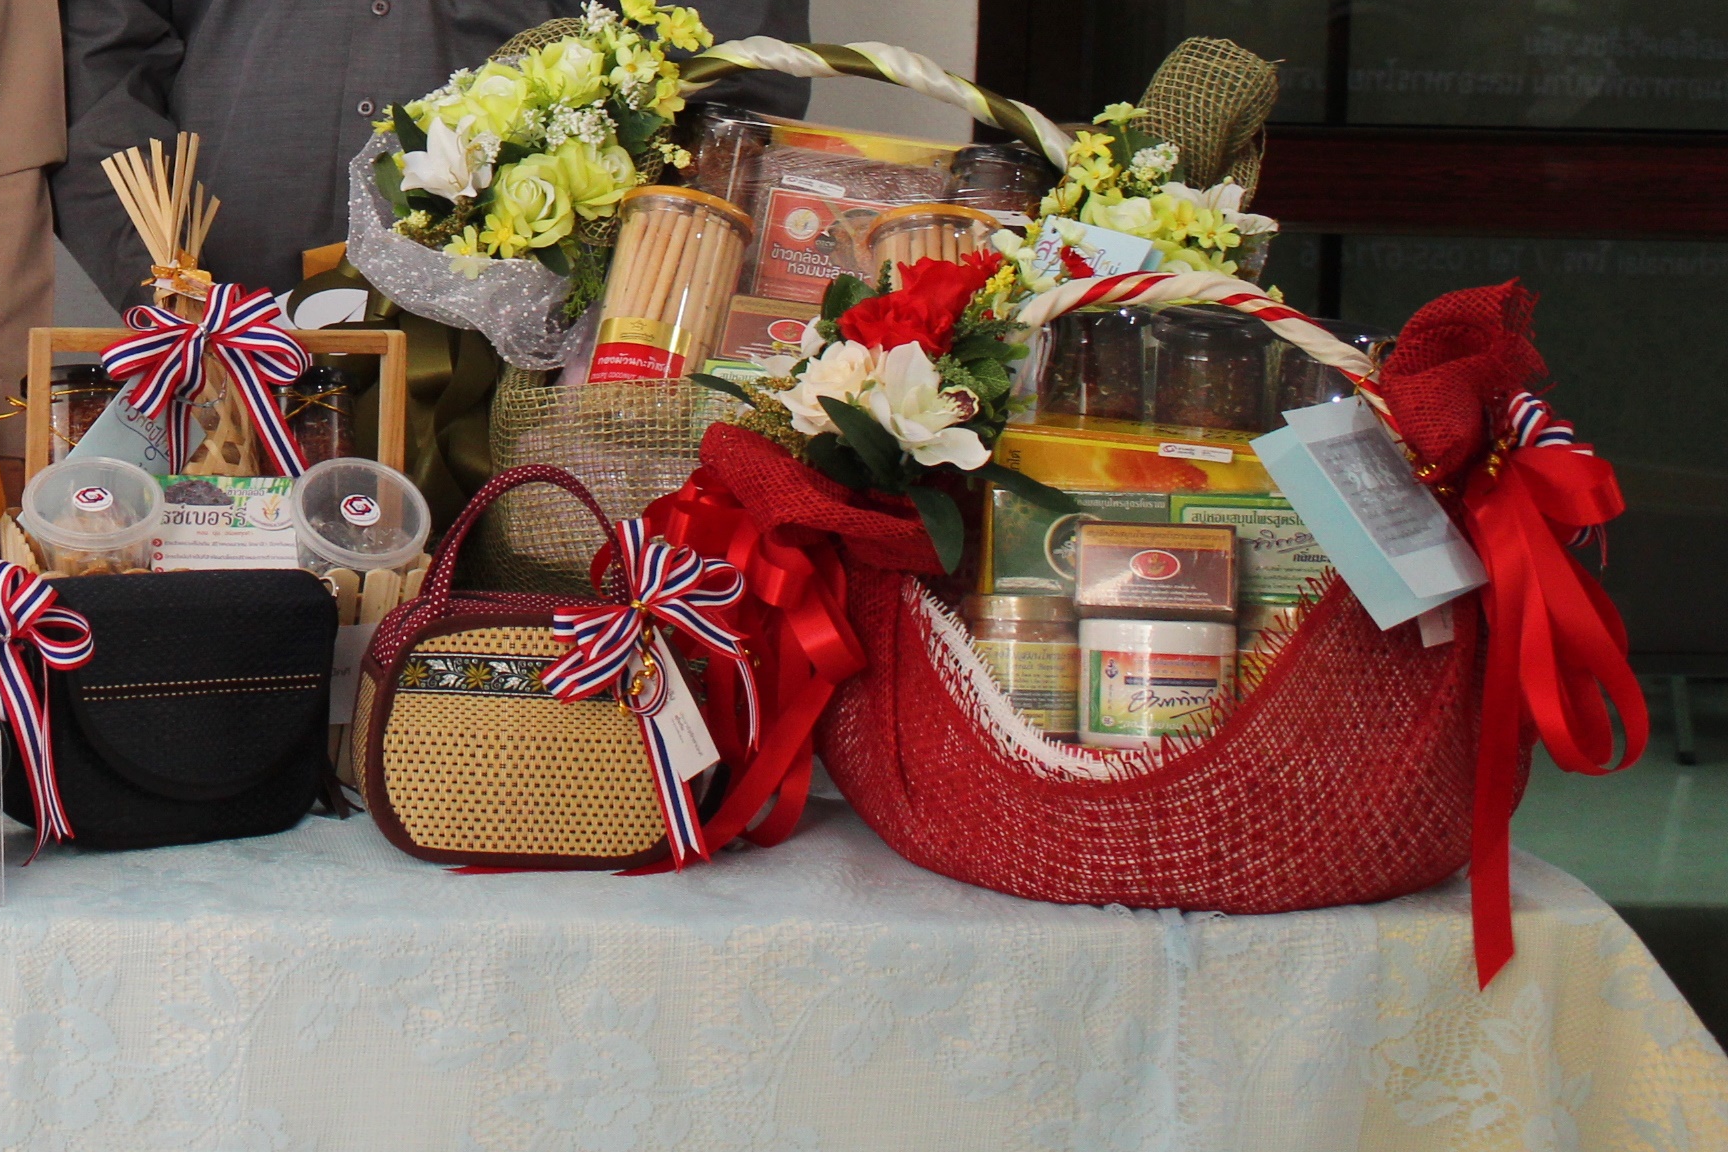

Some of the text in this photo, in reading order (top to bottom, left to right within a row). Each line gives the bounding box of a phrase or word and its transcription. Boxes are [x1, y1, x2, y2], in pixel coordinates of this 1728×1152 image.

[771, 243, 830, 265] ข้าวกล้อง
[162, 502, 248, 526] รซ์เบอร์รี่
[1076, 498, 1165, 512] หอมสมุนไพรสูตรโบราณ
